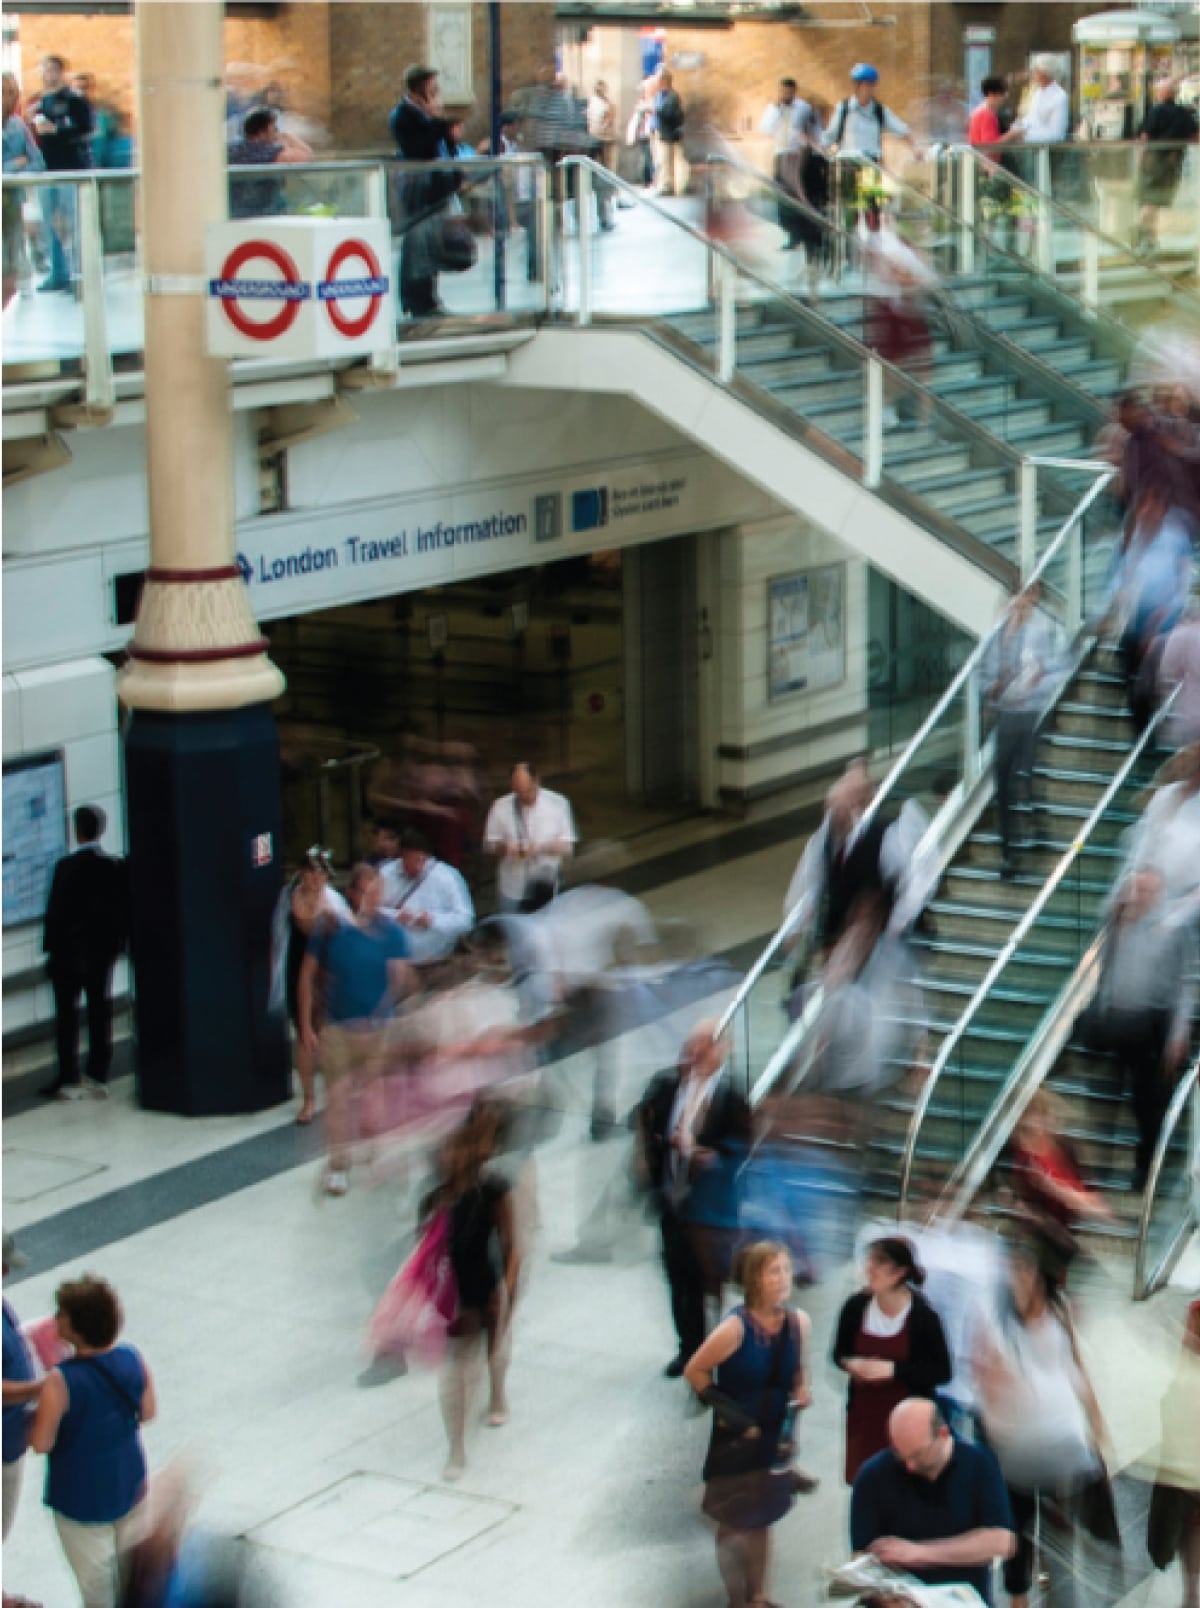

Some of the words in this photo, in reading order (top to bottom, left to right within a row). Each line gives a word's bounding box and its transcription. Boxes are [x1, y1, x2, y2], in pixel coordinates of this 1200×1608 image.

[259, 545, 339, 583] London
[345, 529, 409, 564] Travel
[416, 510, 528, 553] Information
